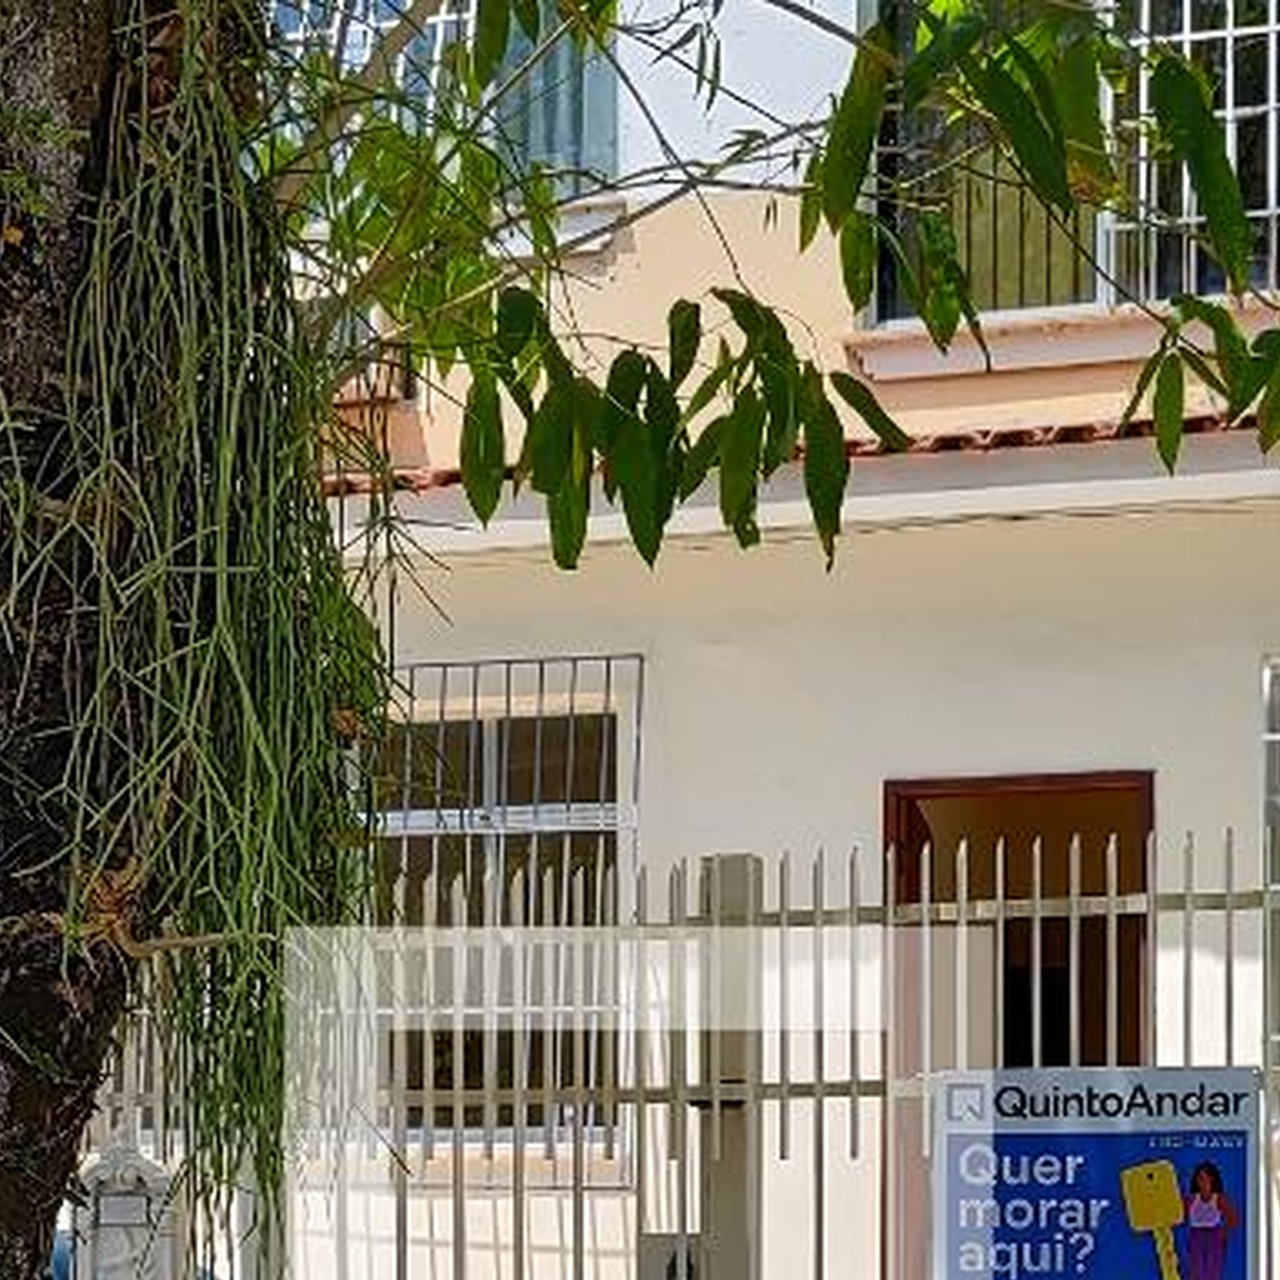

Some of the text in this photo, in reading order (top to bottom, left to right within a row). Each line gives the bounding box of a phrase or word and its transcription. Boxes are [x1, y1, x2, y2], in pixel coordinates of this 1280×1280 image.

[994, 1084, 1249, 1119] QuintoAndar
[959, 1145, 1084, 1186] Quer
[958, 1197, 1109, 1230] morar
[958, 1233, 1095, 1280] aqui?
